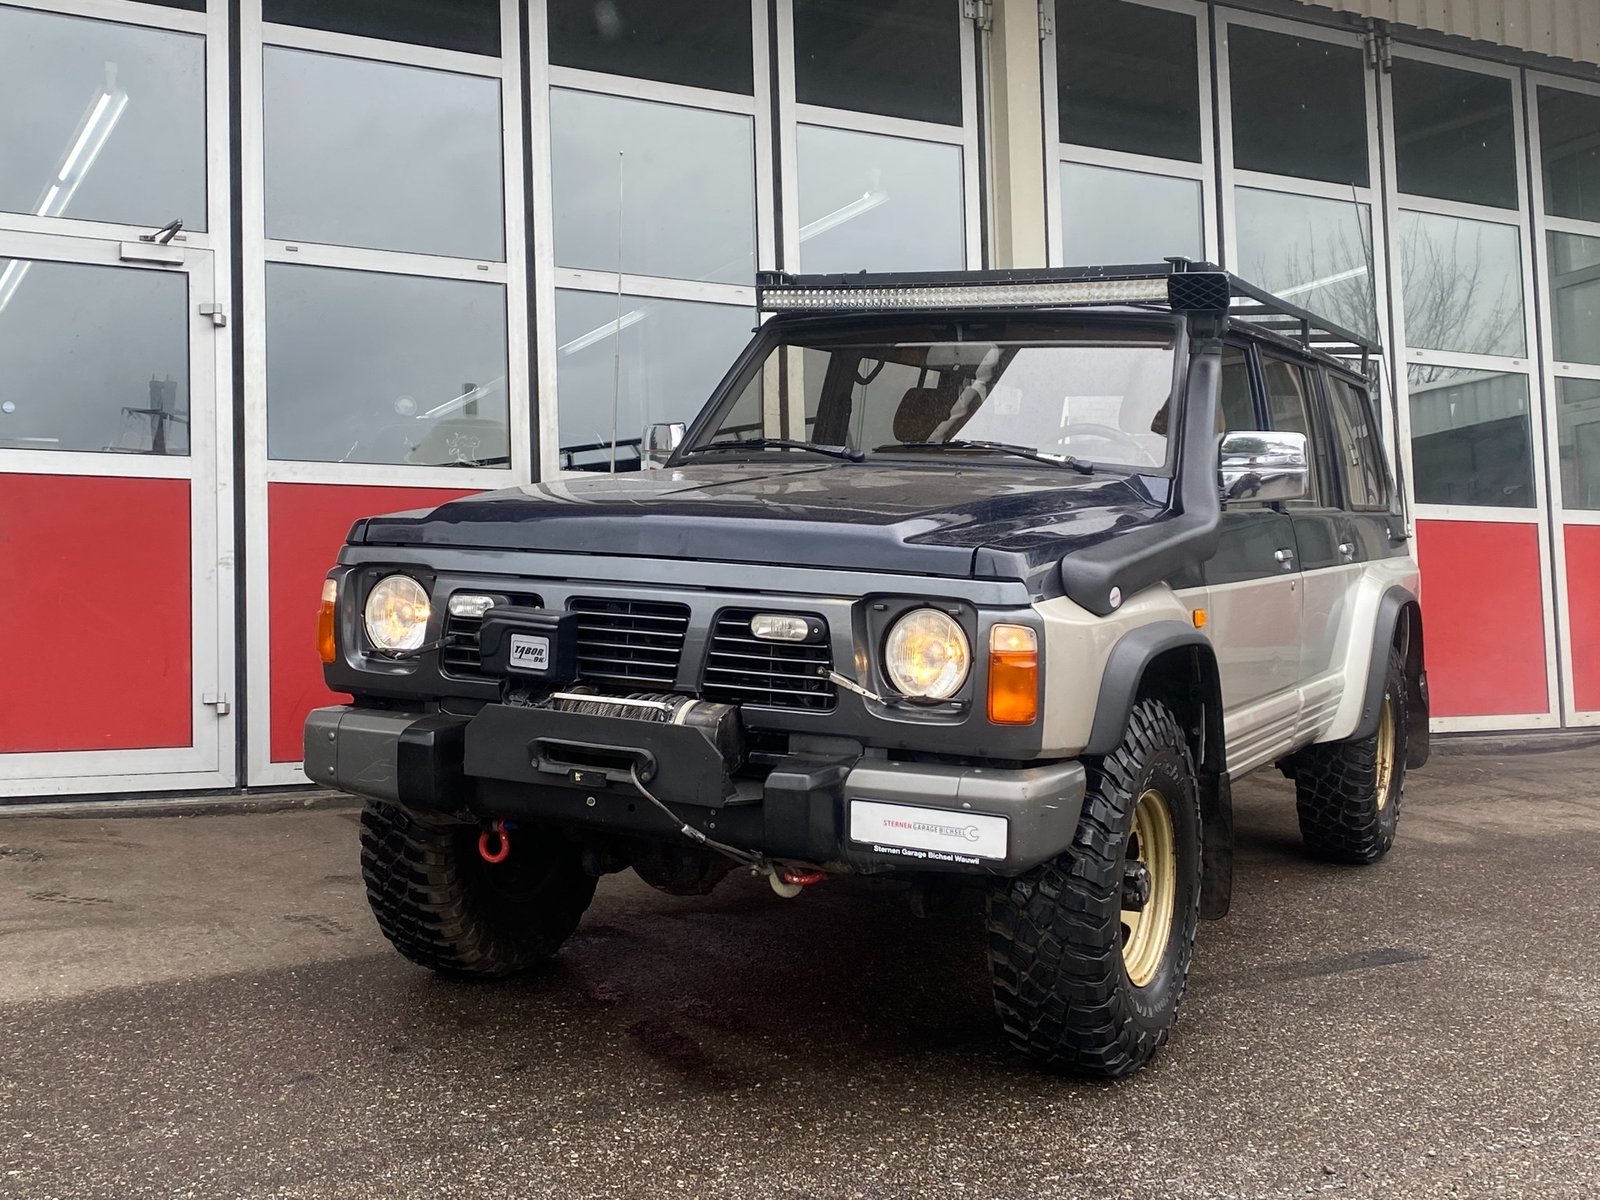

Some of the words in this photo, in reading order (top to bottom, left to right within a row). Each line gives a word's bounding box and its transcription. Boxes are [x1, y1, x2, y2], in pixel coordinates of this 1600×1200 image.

[515, 645, 544, 659] TABOR
[883, 819, 912, 829] STERNEN
[912, 822, 938, 833] GARAGE
[939, 827, 965, 836] BICHSEL
[873, 845, 901, 854] Sternen
[901, 848, 927, 858] Garage
[928, 851, 953, 861] Bichsel
[955, 855, 980, 865] Wauwil
